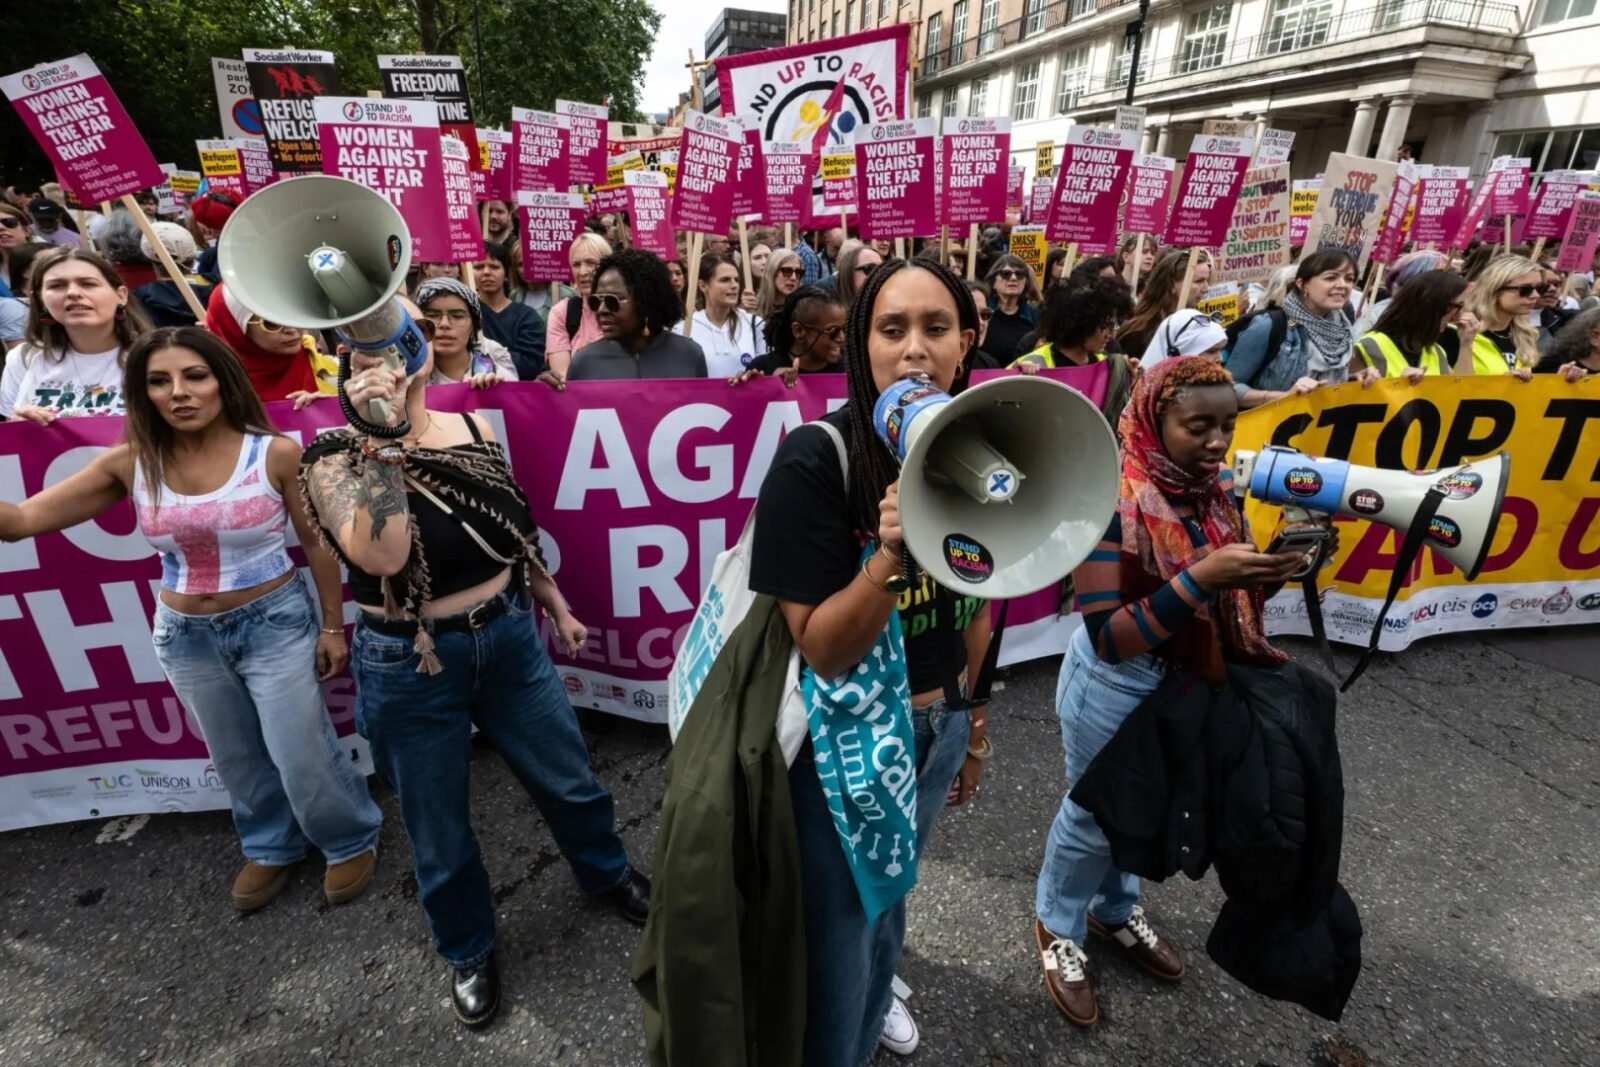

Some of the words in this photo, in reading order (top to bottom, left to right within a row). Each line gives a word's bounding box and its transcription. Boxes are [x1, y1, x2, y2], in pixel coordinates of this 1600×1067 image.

[36, 68, 60, 80] STAND
[60, 64, 70, 73] UP
[52, 70, 79, 84] RACISM
[390, 73, 460, 92] FREEDOM
[777, 60, 806, 84] UP
[814, 54, 843, 73] TO
[848, 61, 893, 123] RACIS
[24, 82, 91, 114] WOMEN
[37, 96, 108, 131] AGAINST
[364, 104, 393, 112] STAND
[395, 105, 408, 114] UP
[366, 112, 378, 122] TO
[380, 114, 412, 123] RACISM
[706, 120, 722, 129] STAND
[45, 126, 82, 146] THE
[78, 114, 116, 136] FAR
[520, 122, 558, 138] WOMEN
[886, 124, 904, 132] STAND
[1120, 122, 1138, 131] ZONE
[333, 127, 414, 148] WOMEN
[520, 134, 564, 150] AGAINST
[582, 137, 599, 148] FAR
[688, 131, 728, 154] WOMEN
[952, 136, 995, 149] WOMEN
[56, 134, 108, 161] RIGHT
[278, 142, 299, 152] Open
[520, 144, 540, 156] THE
[541, 147, 560, 158] FAR
[865, 140, 916, 159] WOMEN
[1040, 146, 1052, 158] NOT
[202, 152, 237, 162] Refugees
[280, 153, 293, 162] No
[338, 147, 428, 168] AGAINST
[520, 154, 550, 168] RIGHT
[684, 148, 732, 170] AGAINST
[766, 155, 800, 165] WOMEN
[950, 149, 1002, 162] AGAINST
[1072, 147, 1118, 164] WOMEN
[1194, 154, 1236, 170] WOMEN
[206, 164, 238, 172] welcome
[766, 165, 806, 175] AGAINST
[866, 154, 925, 172] AGAINST
[950, 162, 974, 175] THE
[975, 162, 997, 174] FAR
[1067, 162, 1121, 178] AGAINST
[338, 167, 380, 188] THE
[384, 168, 424, 188] FAR
[684, 161, 706, 178] THE
[706, 166, 728, 183] FAR
[866, 172, 892, 186] THE
[895, 169, 920, 184] FAR
[1138, 168, 1165, 179] WOMEN
[1189, 169, 1239, 184] AGAINST
[682, 176, 716, 194] RIGHT
[767, 176, 786, 184] THE
[787, 176, 804, 185] FAR
[824, 181, 843, 190] Stop
[950, 175, 985, 188] RIGHT
[1065, 176, 1088, 190] THE
[1090, 178, 1112, 192] FAR
[1134, 178, 1168, 190] AGAINST
[1344, 170, 1378, 192] STOP
[1425, 180, 1457, 188] WOMEN
[632, 187, 660, 198] WOMEN
[767, 185, 795, 195] RIGHT
[867, 184, 908, 200] RIGHT
[1134, 187, 1150, 196] THE
[1150, 188, 1164, 198] FAR
[1186, 182, 1210, 196] THE
[1210, 184, 1232, 197] FAR
[1424, 189, 1460, 198] AGAINST
[1546, 184, 1578, 192] WOMEN
[825, 191, 838, 200] far
[1060, 190, 1098, 206] RIGHT
[1132, 196, 1156, 207] RIGHT
[1422, 198, 1440, 206] THE
[1440, 198, 1455, 207] FAR
[634, 199, 666, 210] AGAINST
[1182, 196, 1218, 210] RIGHT
[527, 208, 570, 220] WOMEN
[634, 209, 650, 220] THE
[650, 210, 666, 221] FAR
[1264, 210, 1280, 224] AT
[1420, 206, 1446, 216] RIGHT
[1536, 206, 1564, 216] RIGHT
[528, 220, 577, 231] AGAINST
[637, 220, 658, 230] RIGHT
[872, 219, 904, 228] Refugees
[1336, 208, 1365, 229] YOUR
[528, 230, 550, 241] THE
[552, 230, 574, 242] FAR
[1243, 222, 1288, 240] SUPPORT
[1290, 228, 1305, 238] far
[1320, 224, 1368, 246] RACISM
[529, 240, 563, 252] RIGHT
[1012, 235, 1036, 246] SMASH
[1226, 238, 1281, 256] CHARITIES
[1224, 253, 1265, 270] SUPPORT
[1267, 252, 1282, 265] US
[1356, 496, 1376, 504] STOP
[948, 538, 980, 554] STAND
[950, 546, 963, 558] UP
[964, 552, 980, 562] TO
[951, 556, 989, 572] RACISM
[1442, 597, 1468, 613] eis
[1472, 600, 1496, 612] pcs
[836, 725, 886, 822] union
[88, 774, 133, 790] TUC
[141, 776, 190, 790] UNISON
